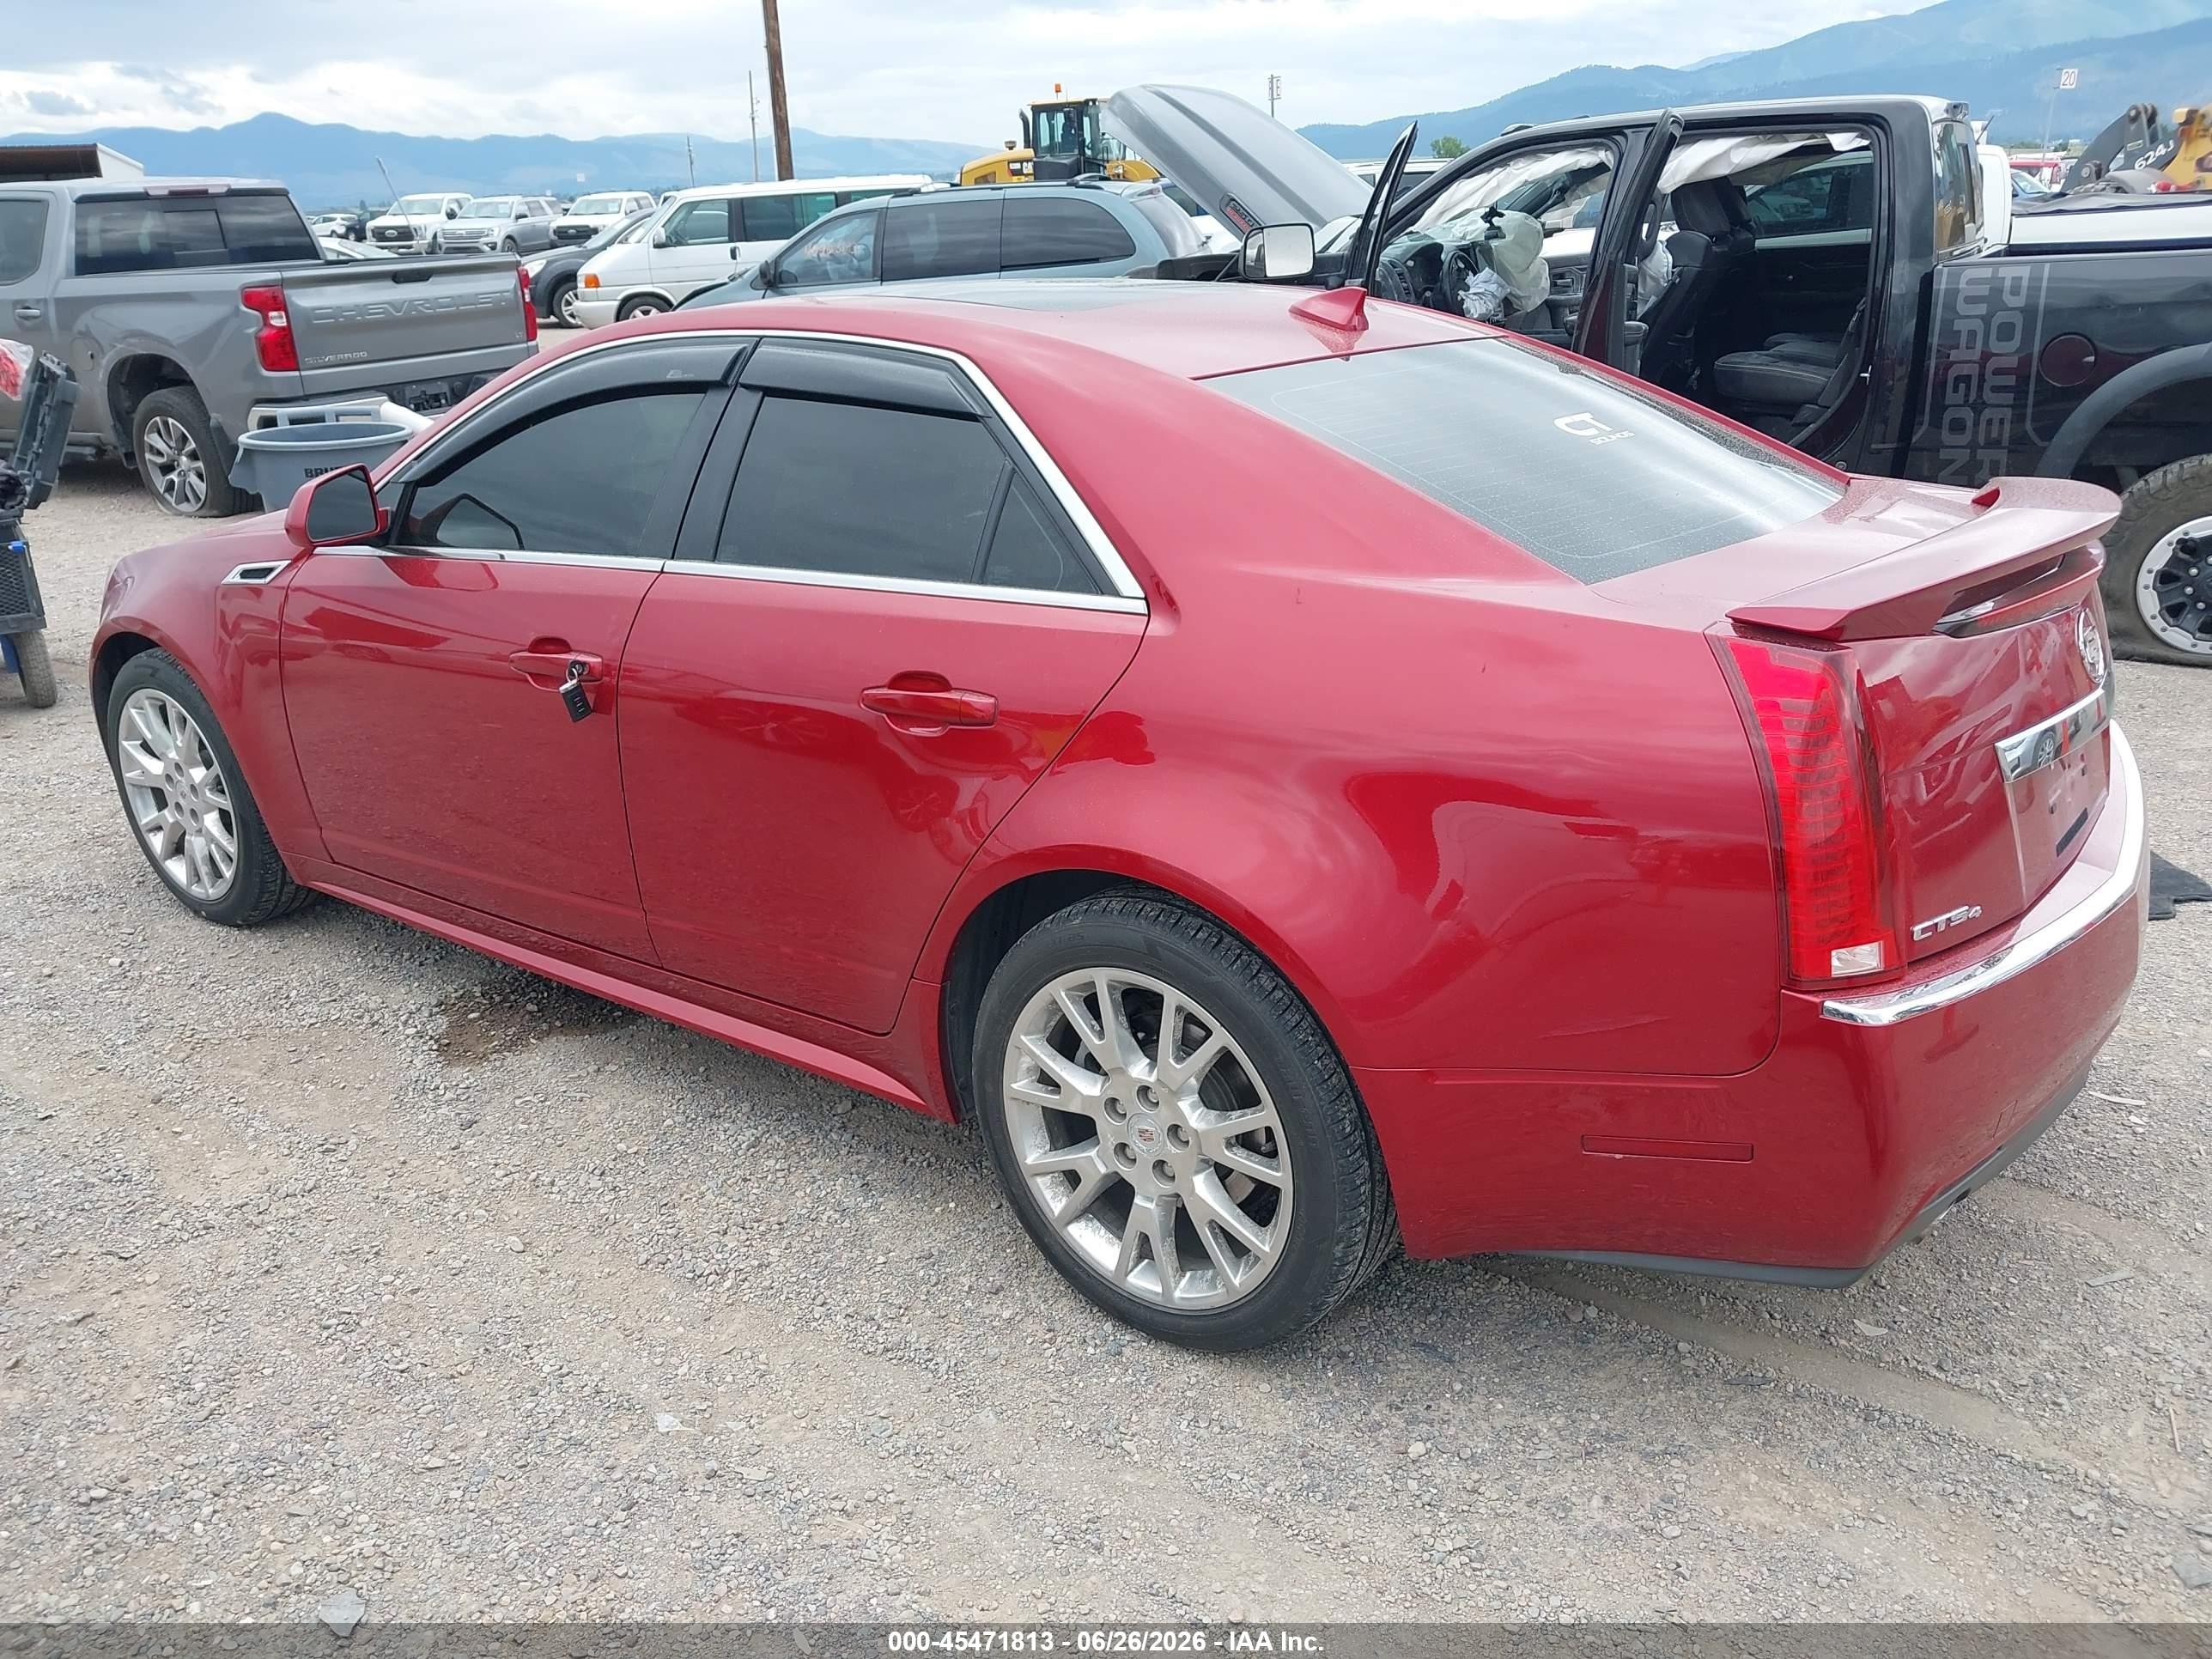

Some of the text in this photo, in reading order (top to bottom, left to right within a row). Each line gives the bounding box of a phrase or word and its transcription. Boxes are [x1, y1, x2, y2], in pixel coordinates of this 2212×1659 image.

[2062, 70, 2075, 86] 20
[1022, 161, 1034, 173] CA
[2134, 139, 2174, 170] 624J
[311, 290, 514, 324] CHEVROLET
[1937, 267, 1993, 485] WAGON
[1977, 265, 2031, 483] POWER
